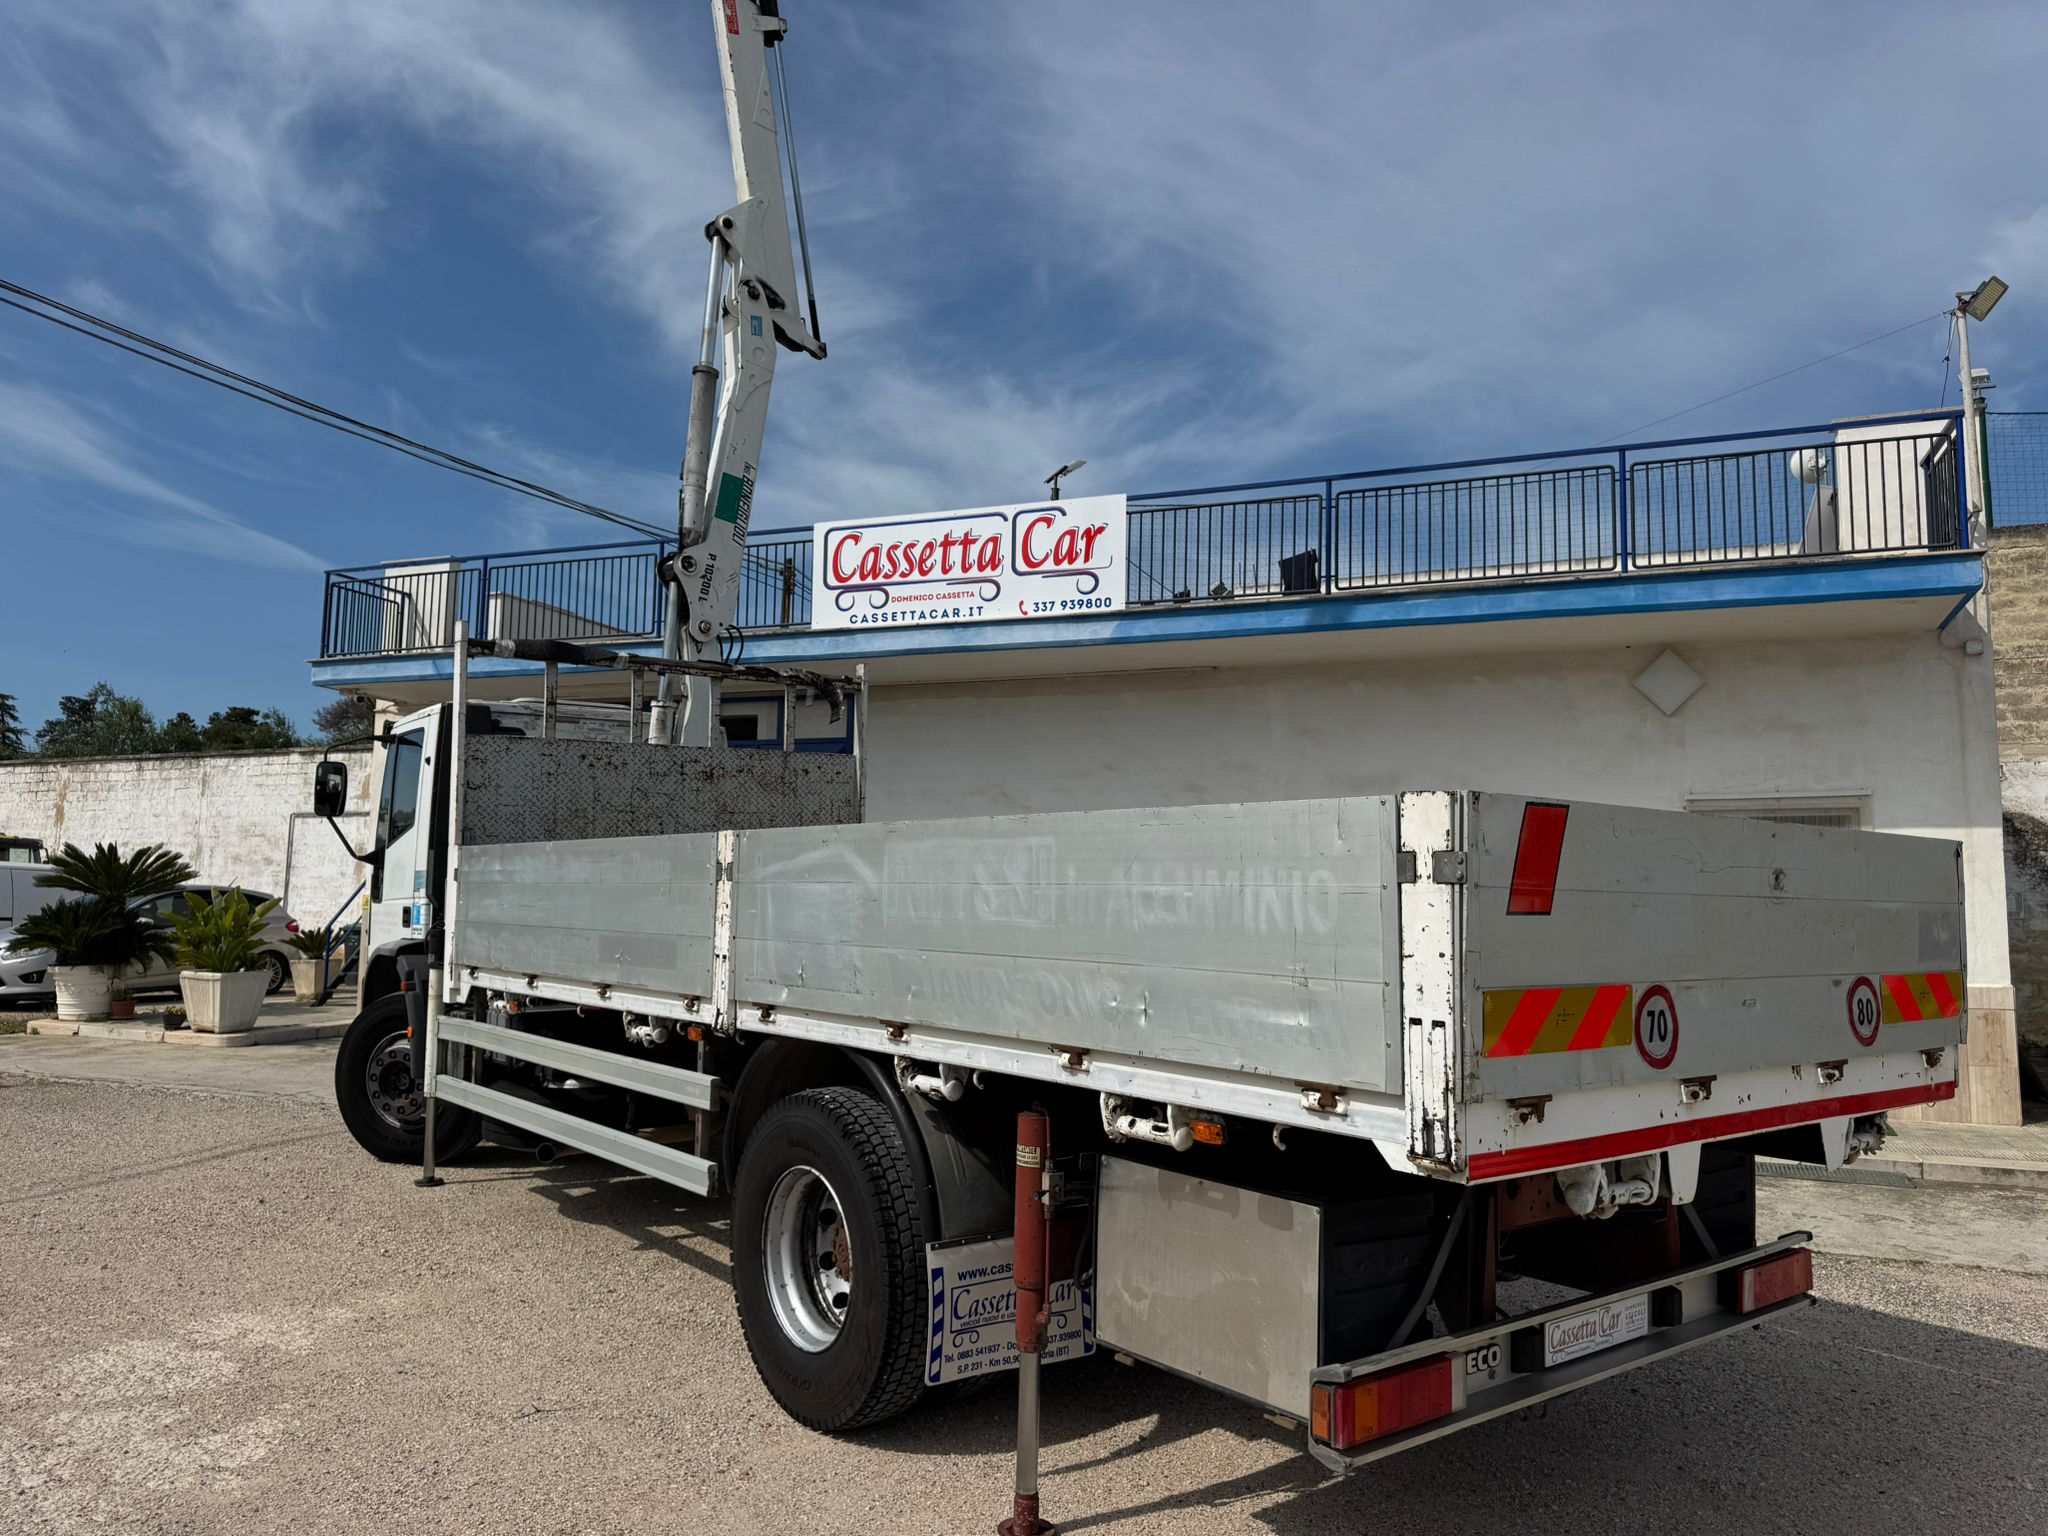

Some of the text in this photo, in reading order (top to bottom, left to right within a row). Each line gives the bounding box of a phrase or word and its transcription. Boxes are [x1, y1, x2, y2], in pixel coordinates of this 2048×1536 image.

[732, 475, 754, 547] BONFIGLIOLI
[832, 513, 1108, 583] Cassetta Car
[700, 563, 715, 595] 10200
[891, 590, 975, 603] DOMENICO CASSETTA
[1033, 597, 1112, 613] 337 939800
[849, 606, 984, 624] CASSETTACAR.IT
[1646, 1009, 1668, 1043] 70
[1857, 998, 1873, 1026] 80
[958, 1262, 1014, 1280] www.cas
[953, 1288, 1017, 1320] Cassett
[1551, 1305, 1622, 1350] Cassetta Car
[944, 1354, 955, 1363] Tel.
[957, 1349, 974, 1361] 0883
[974, 1344, 1000, 1357] 541937
[1047, 1329, 1082, 1345] 37.939800
[970, 1361, 983, 1372] 231
[989, 1357, 1001, 1367] Km
[1040, 1350, 1055, 1359] dria
[1056, 1345, 1070, 1357] (BT)
